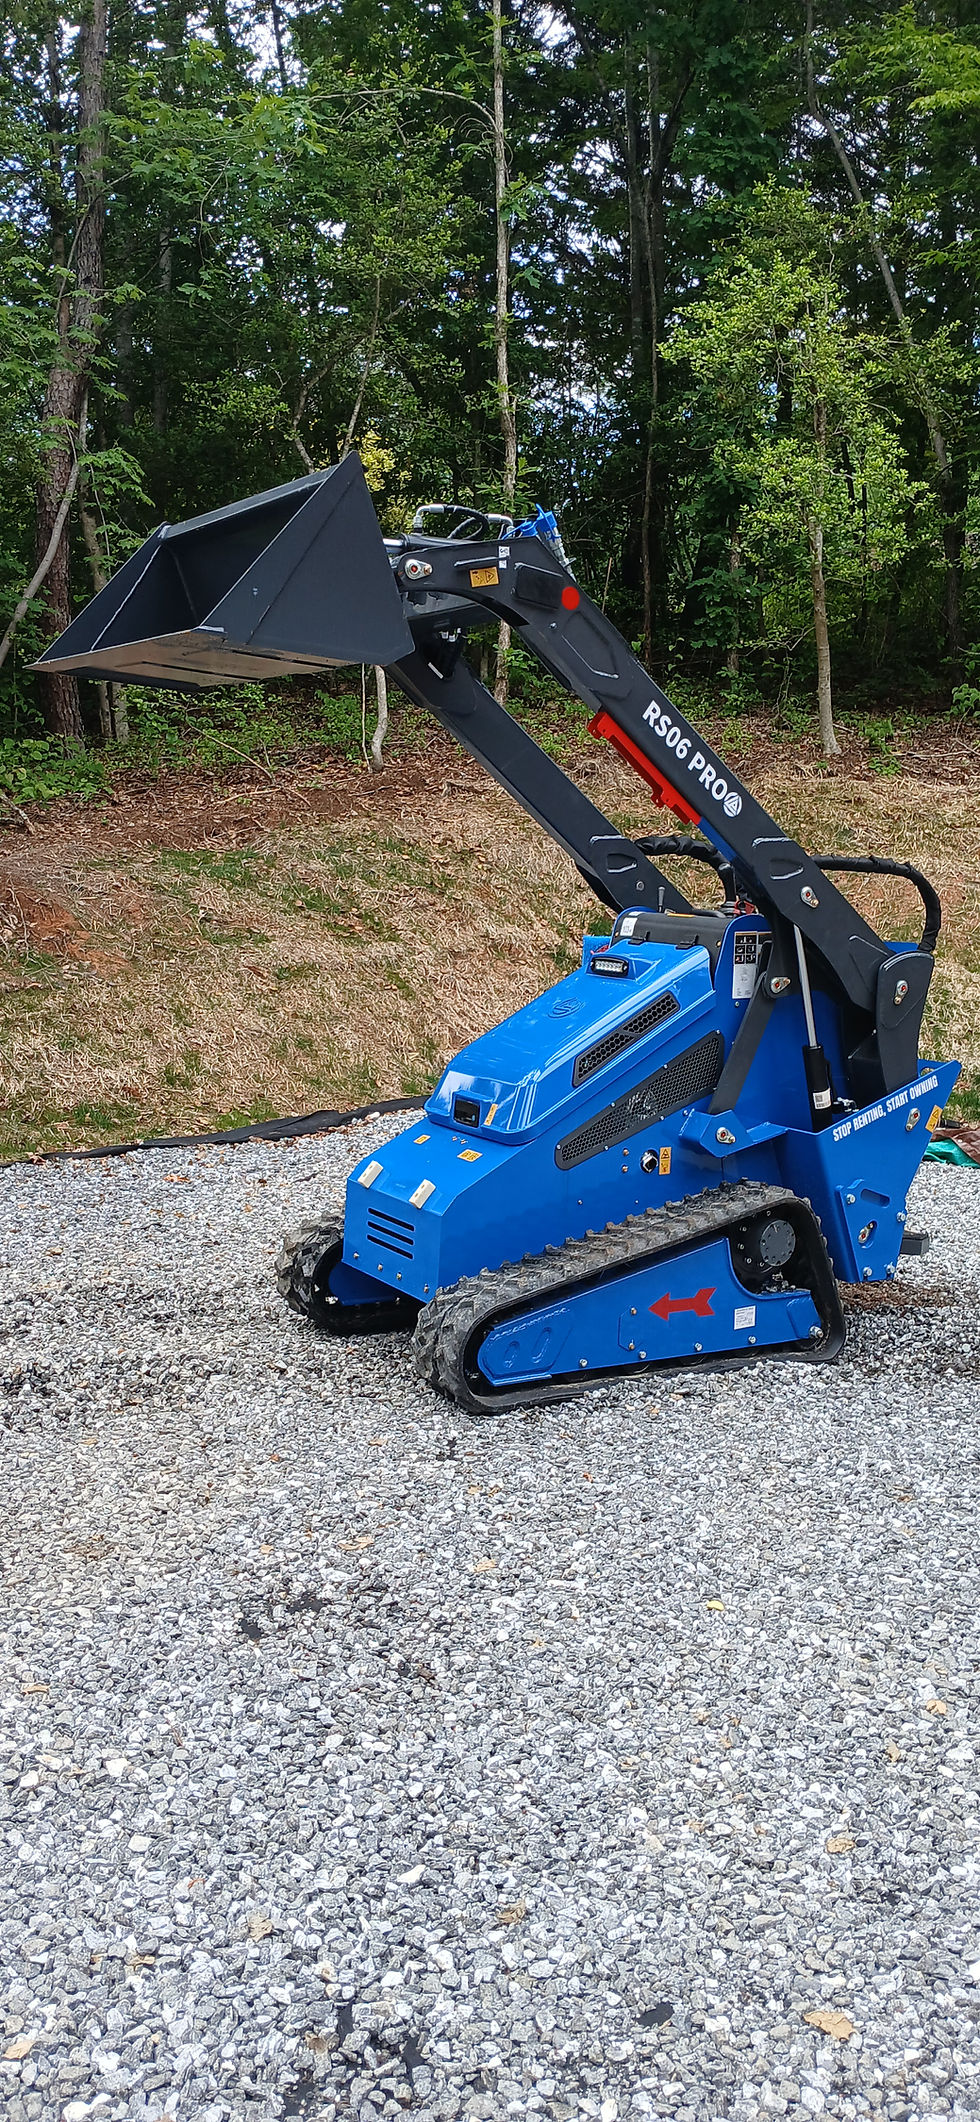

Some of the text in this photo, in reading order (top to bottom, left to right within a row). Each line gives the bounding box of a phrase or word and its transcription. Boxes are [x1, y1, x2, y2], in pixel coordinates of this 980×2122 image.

[642, 700, 728, 800] RS06 PRO
[832, 1075, 939, 1142] STOP RENTING, START OWNING
